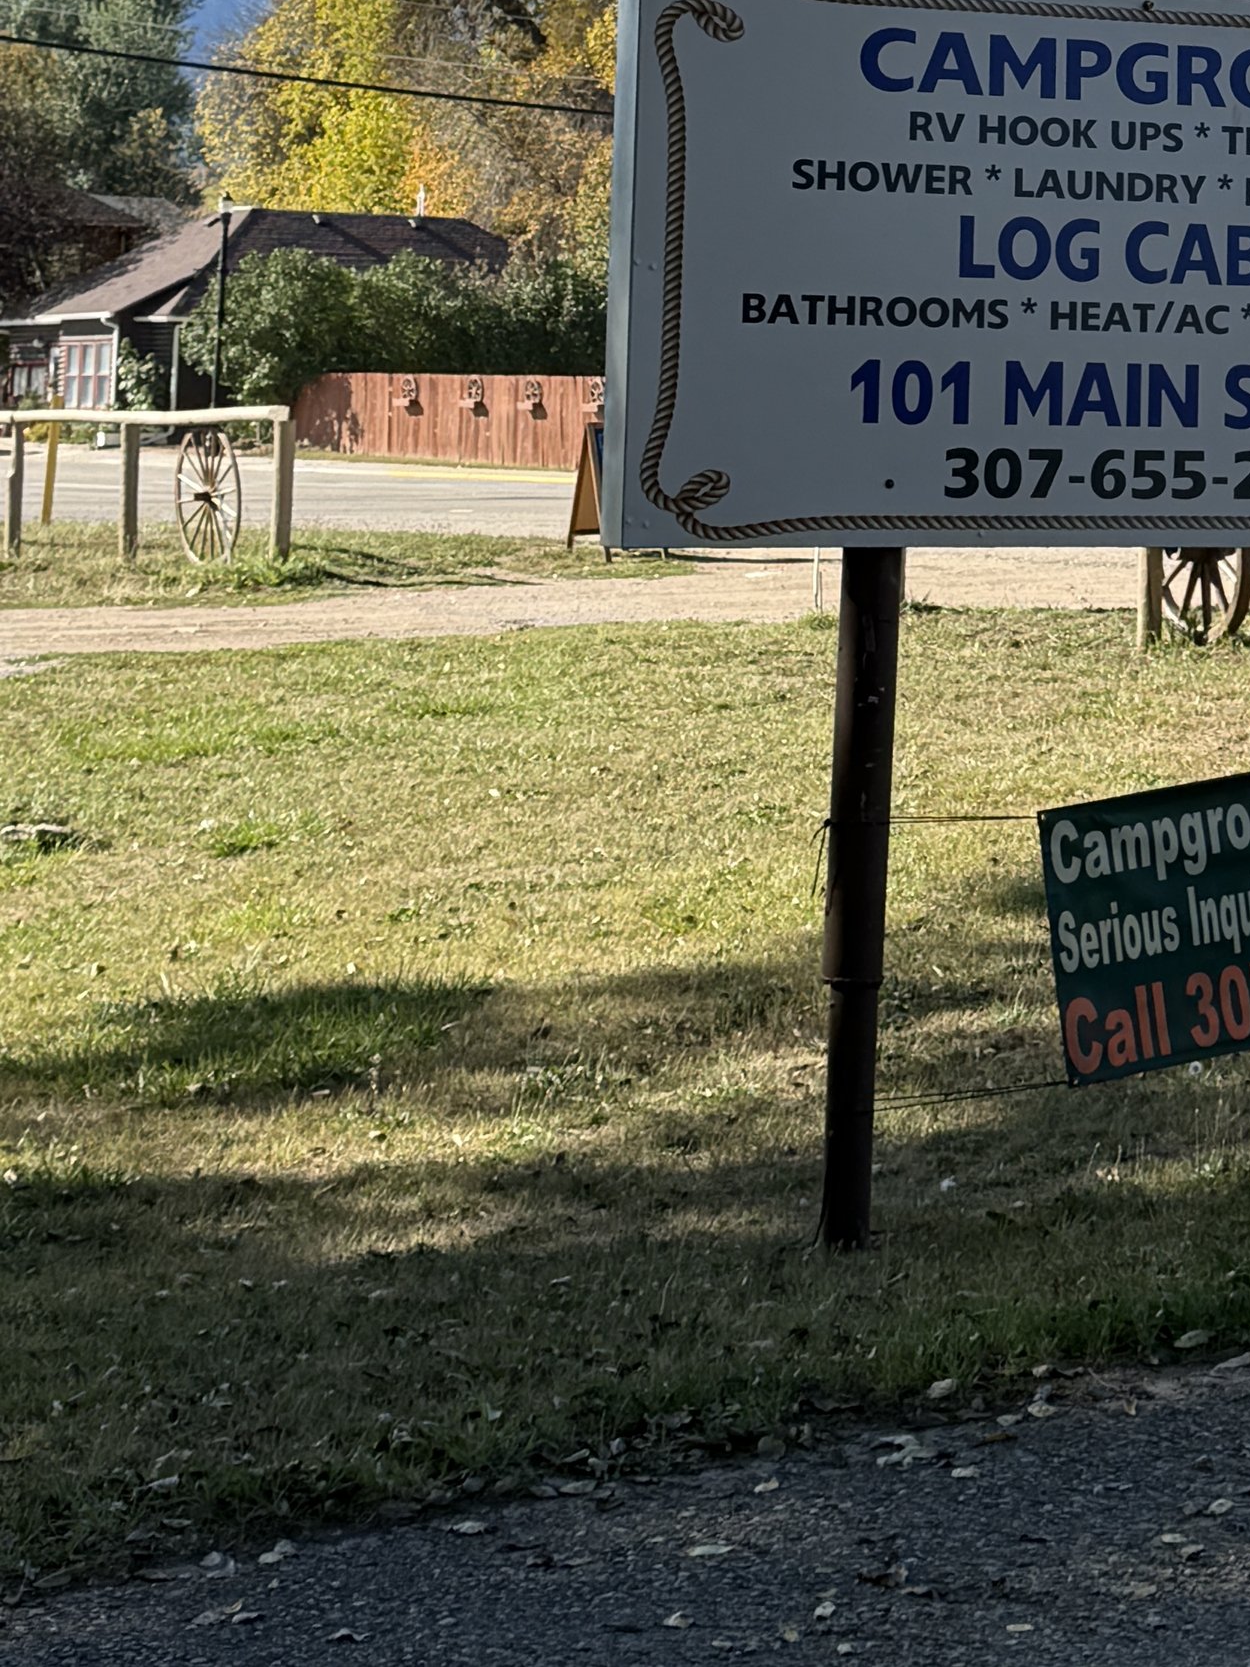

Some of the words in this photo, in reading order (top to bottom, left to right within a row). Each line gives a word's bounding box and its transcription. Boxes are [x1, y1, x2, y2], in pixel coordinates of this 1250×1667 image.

[908, 111, 965, 142] RV
[978, 114, 1098, 149] HOOK
[1110, 121, 1183, 153] UPS
[791, 159, 973, 196] SHOWER
[1014, 168, 1206, 204] LAUNDRY
[958, 215, 1101, 284] LOG
[741, 293, 1009, 330] BATHROOMS
[1050, 300, 1230, 336] HEAT/AC
[850, 359, 972, 426] 101
[1004, 360, 1200, 429] MAIN
[1058, 899, 1180, 975] Serious
[1064, 981, 1172, 1076] Call
